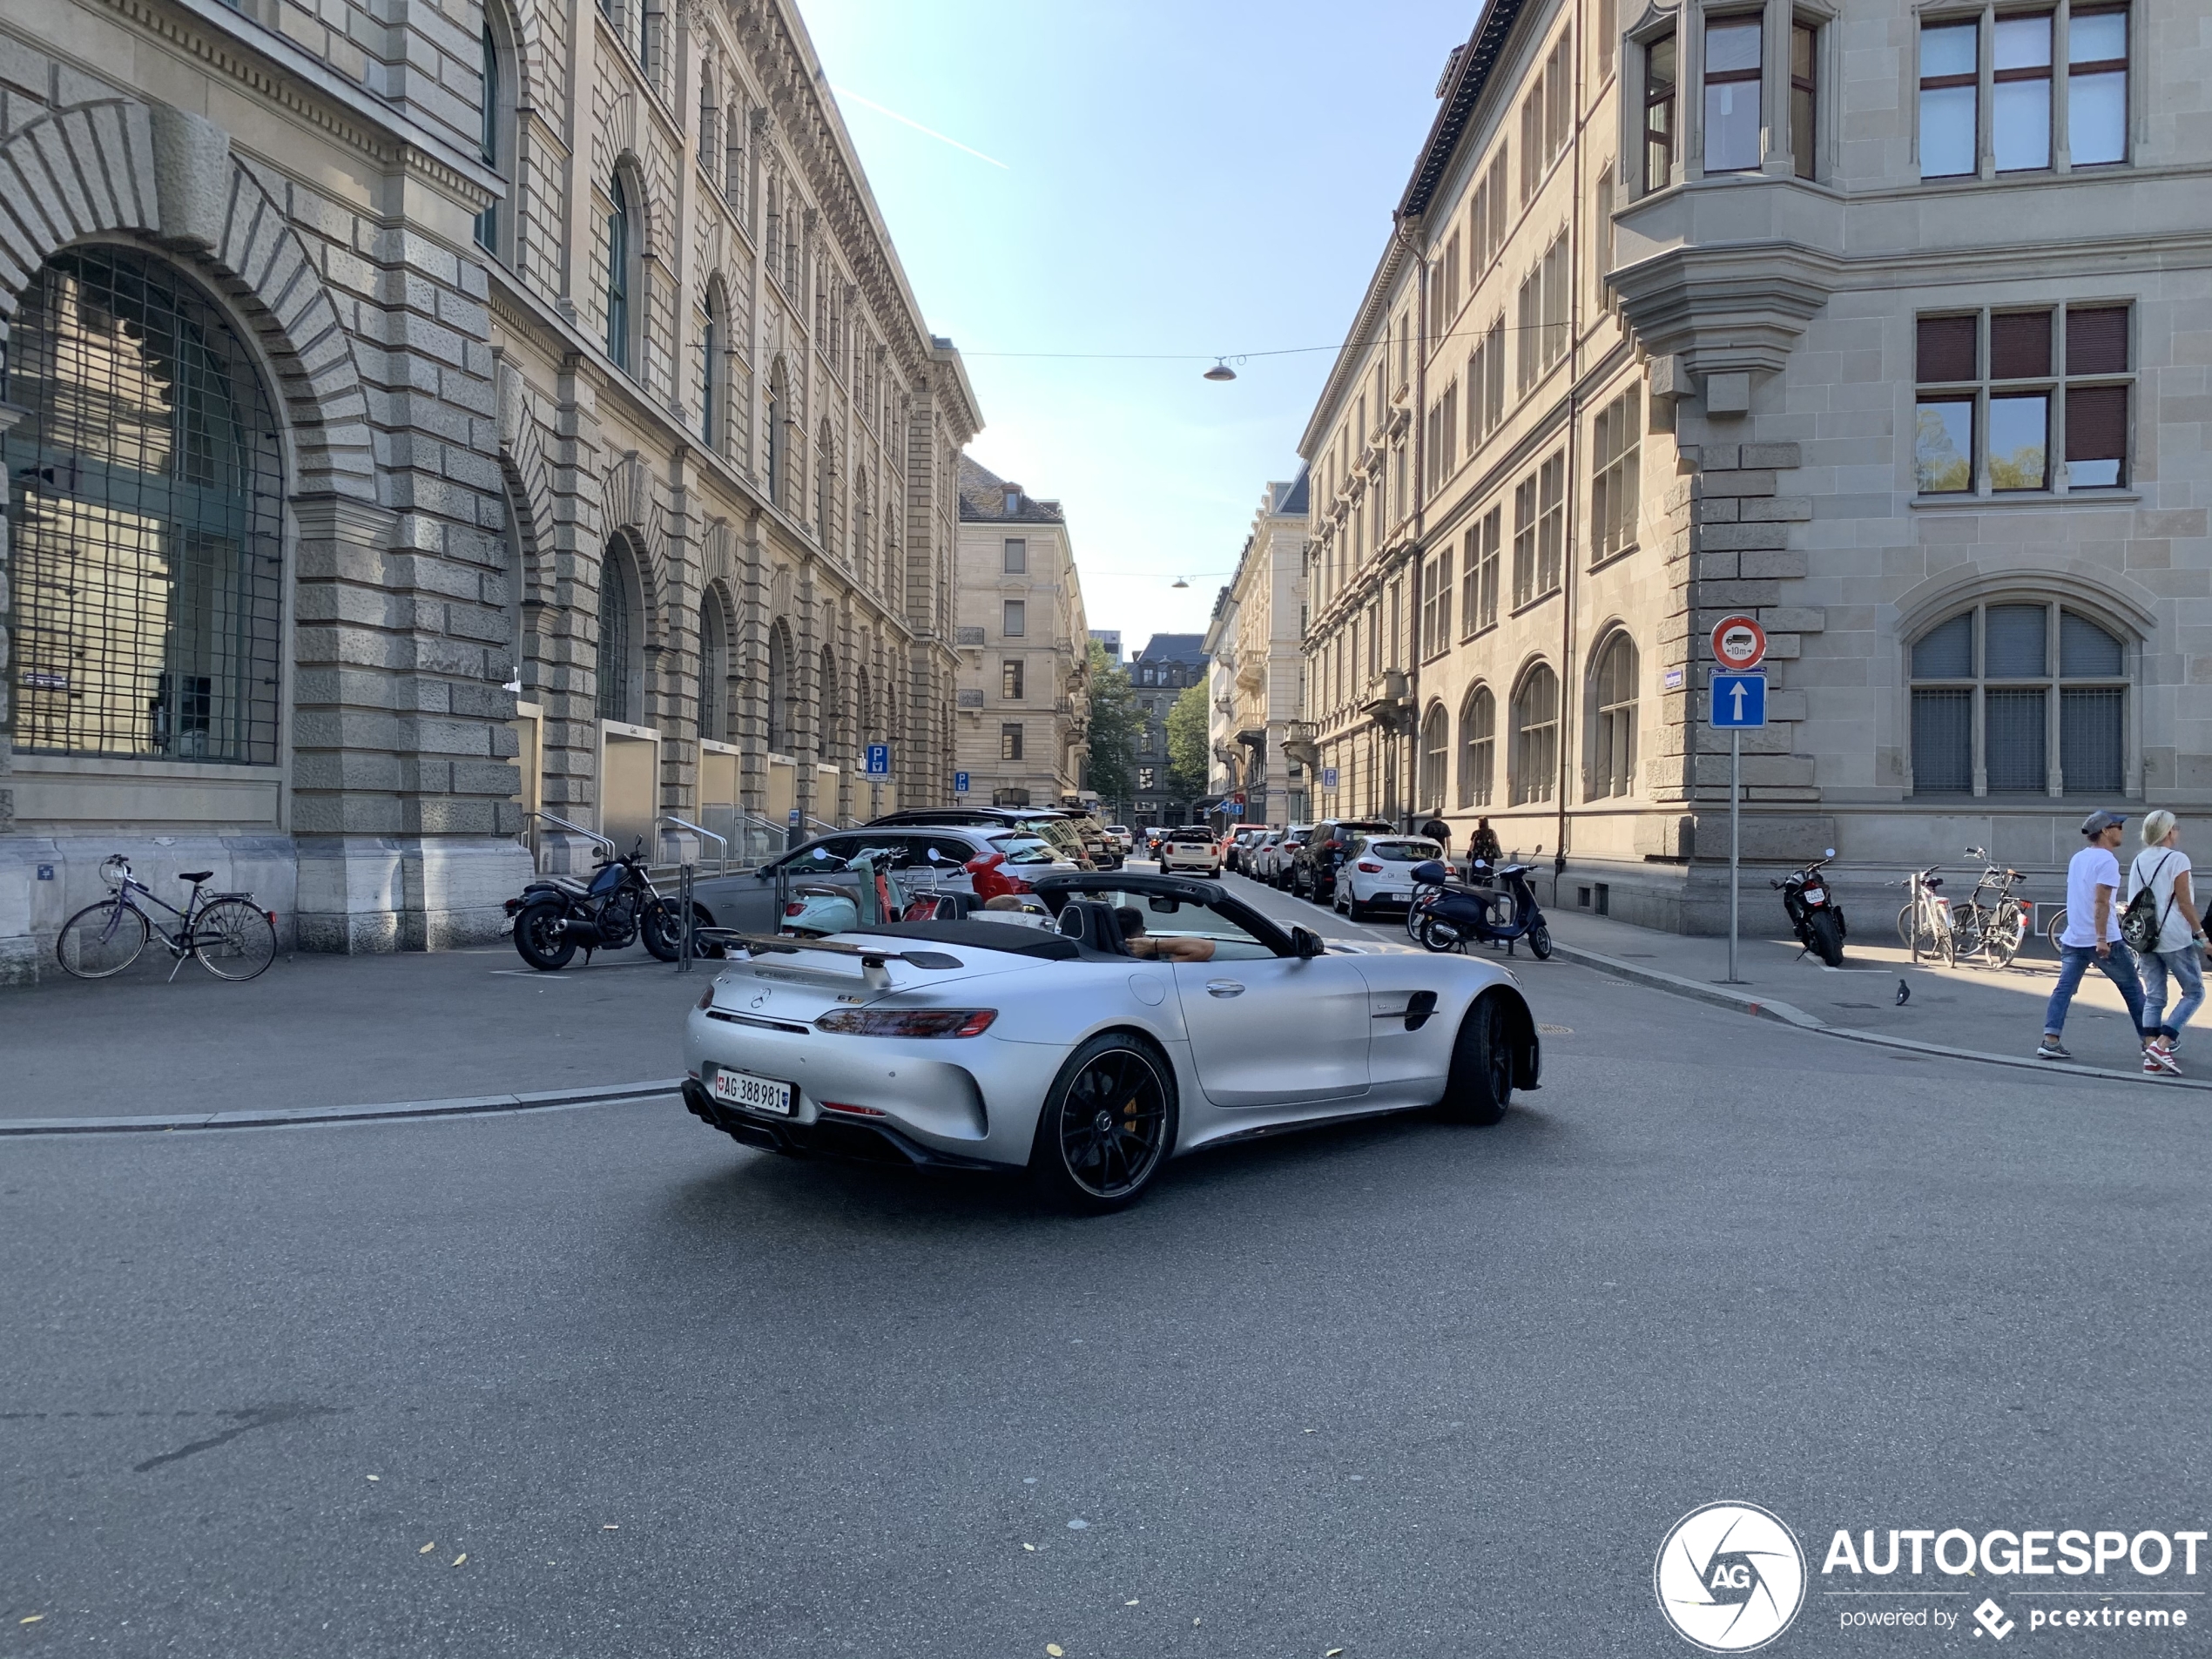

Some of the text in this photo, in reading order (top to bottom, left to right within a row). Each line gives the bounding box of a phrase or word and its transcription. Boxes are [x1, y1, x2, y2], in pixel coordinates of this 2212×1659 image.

[1731, 646, 1746, 655] 10m
[873, 746, 883, 761] P
[959, 773, 965, 783] P
[1328, 770, 1334, 779] P
